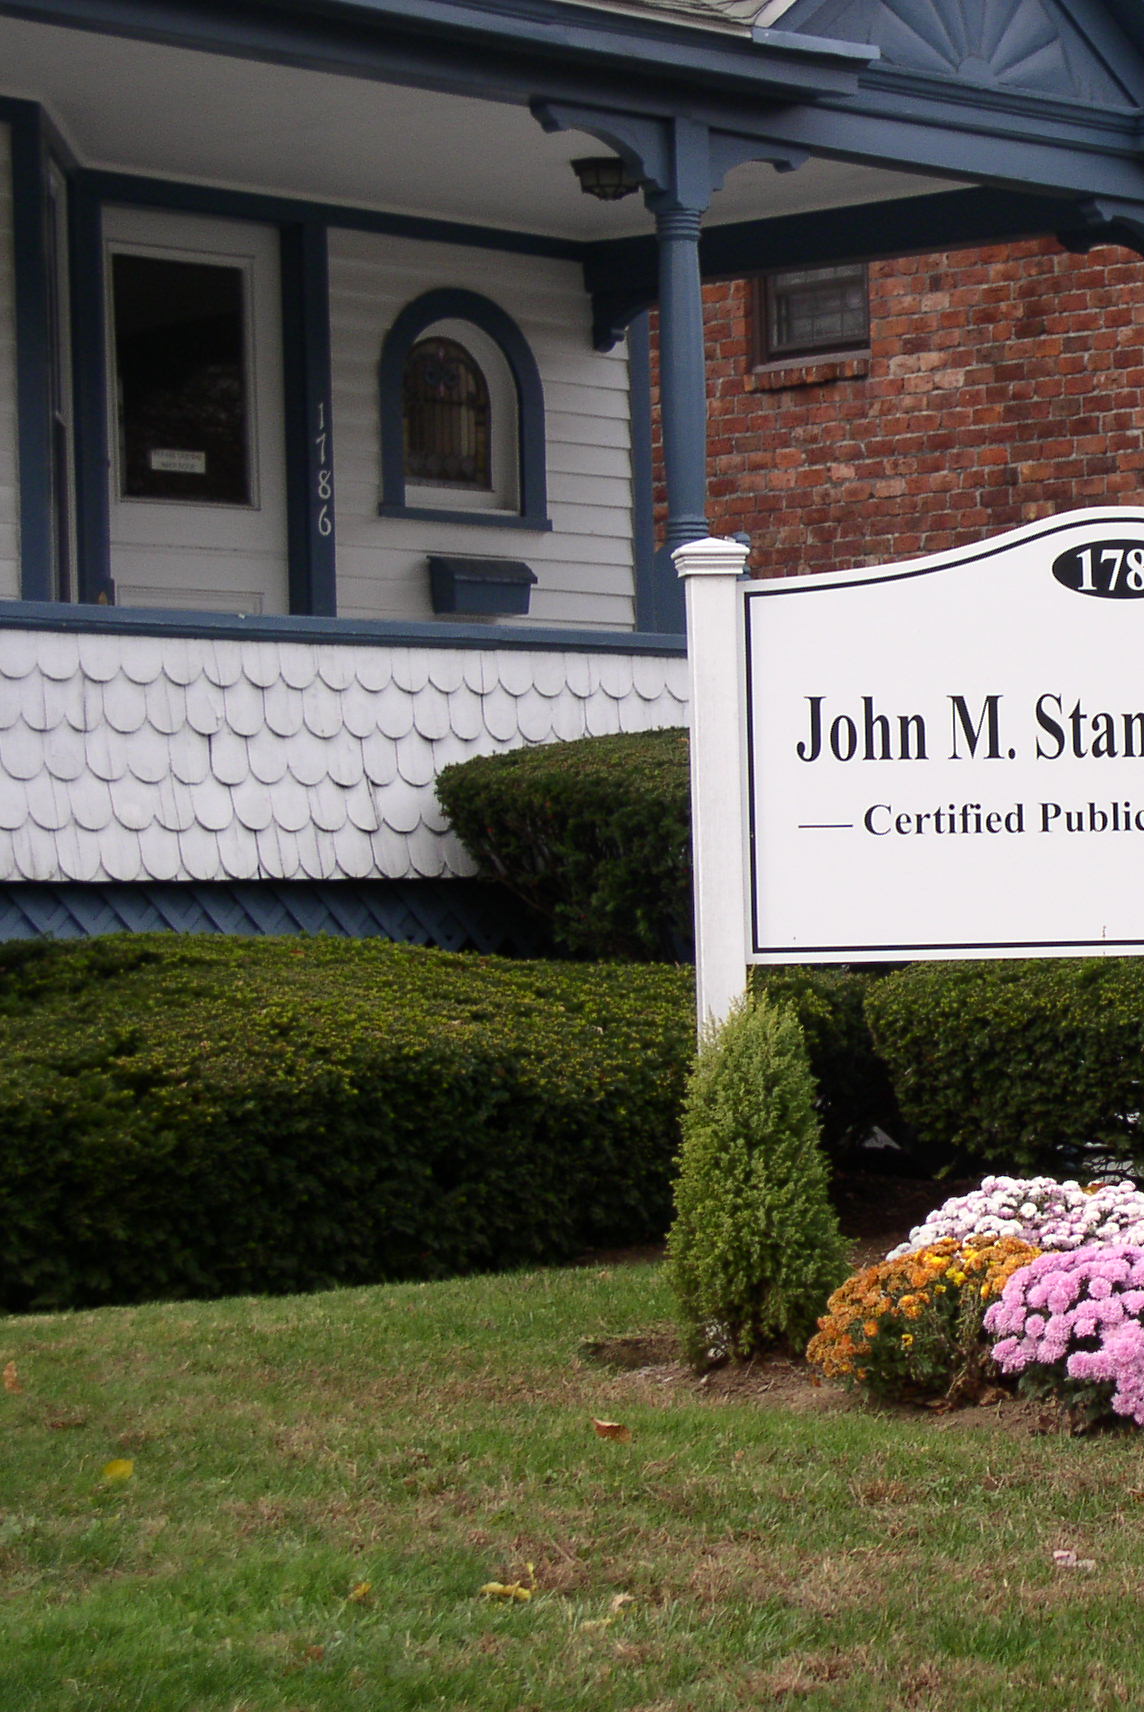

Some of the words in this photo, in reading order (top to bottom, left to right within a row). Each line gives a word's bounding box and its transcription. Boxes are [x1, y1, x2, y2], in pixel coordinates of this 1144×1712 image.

[316, 402, 331, 536] 1786
[796, 694, 929, 763] John
[946, 694, 1016, 760] M.
[864, 803, 1025, 836] Certified
